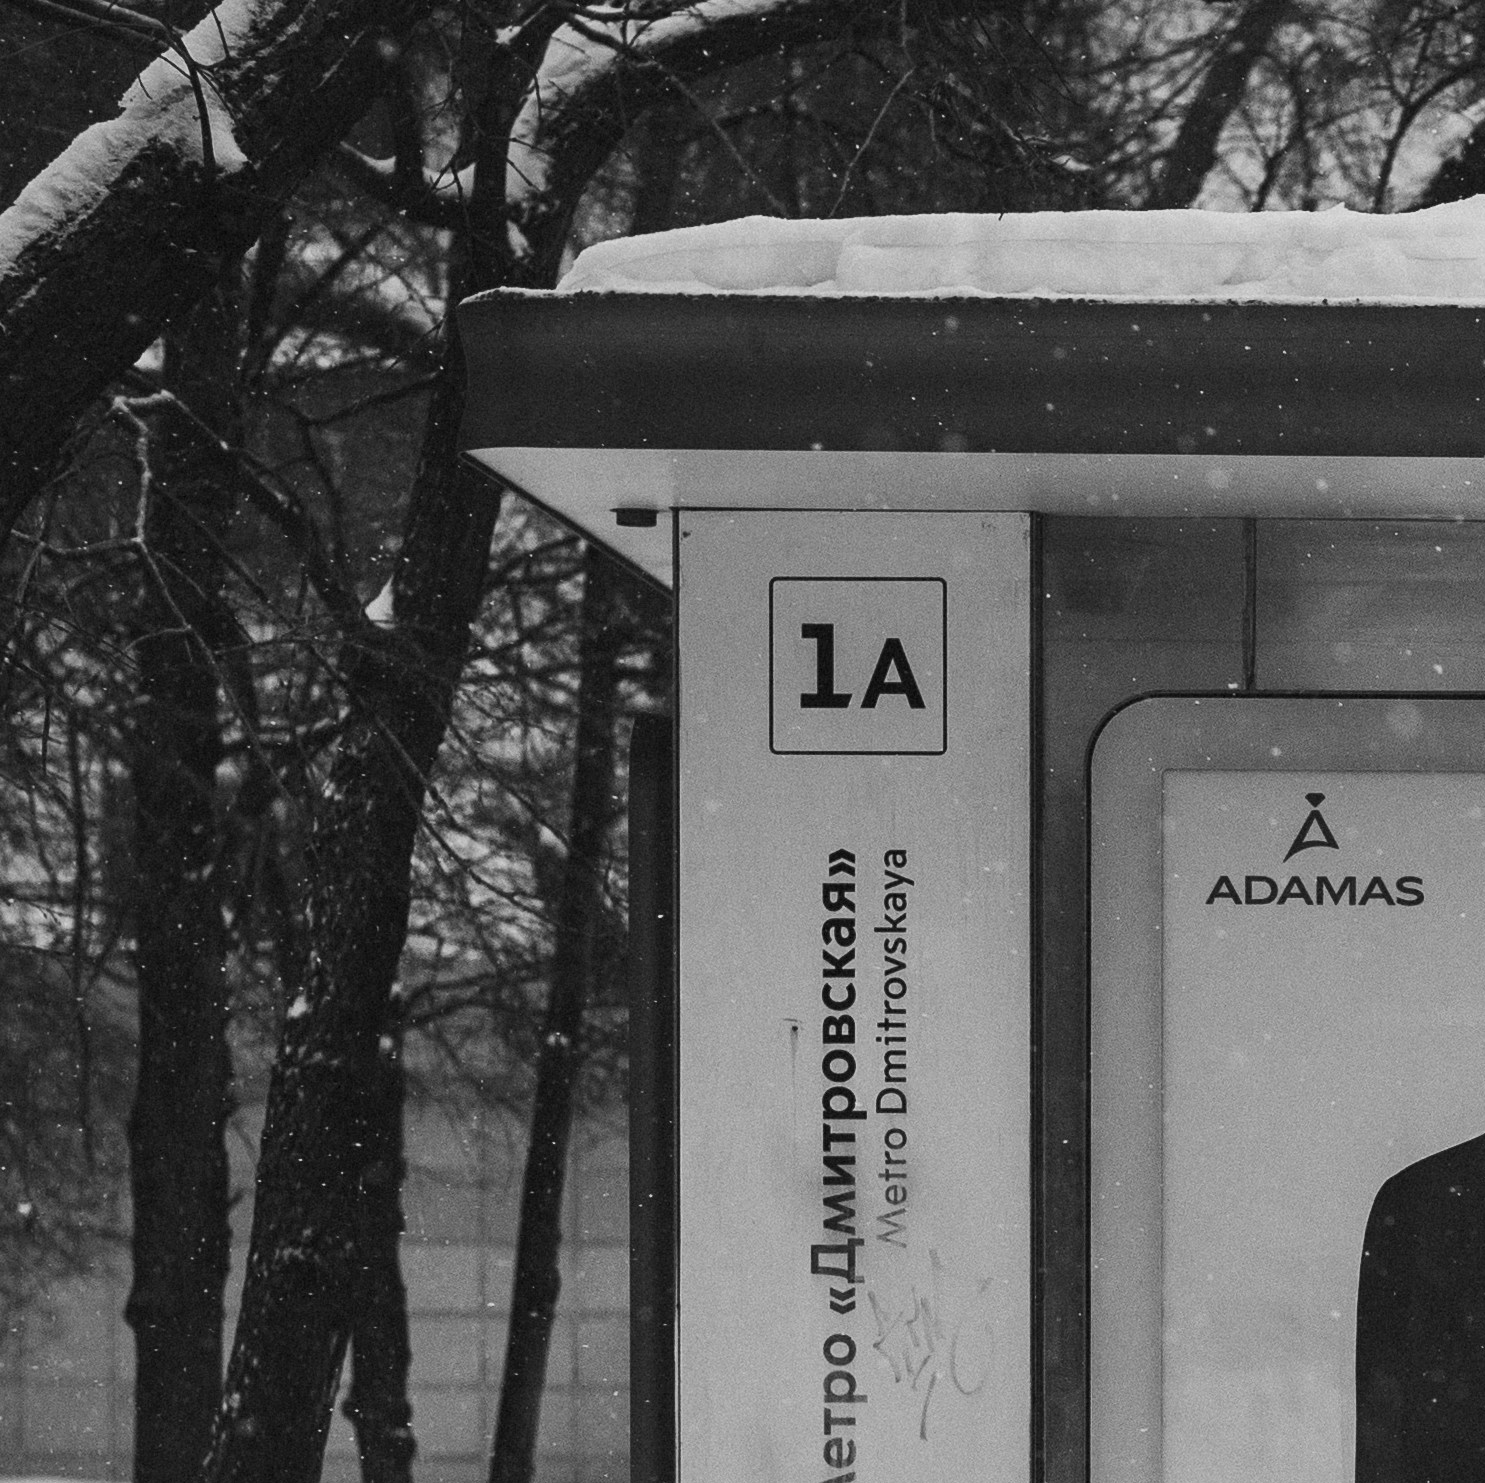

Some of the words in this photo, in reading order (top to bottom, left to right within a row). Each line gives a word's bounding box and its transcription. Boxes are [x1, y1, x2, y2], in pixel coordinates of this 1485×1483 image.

[873, 848, 915, 1115] Dmitrovskaya
[1205, 875, 1425, 907] ADAMAS
[810, 848, 868, 1315] «Дмитровская»
[875, 1126, 908, 1249] Metro
